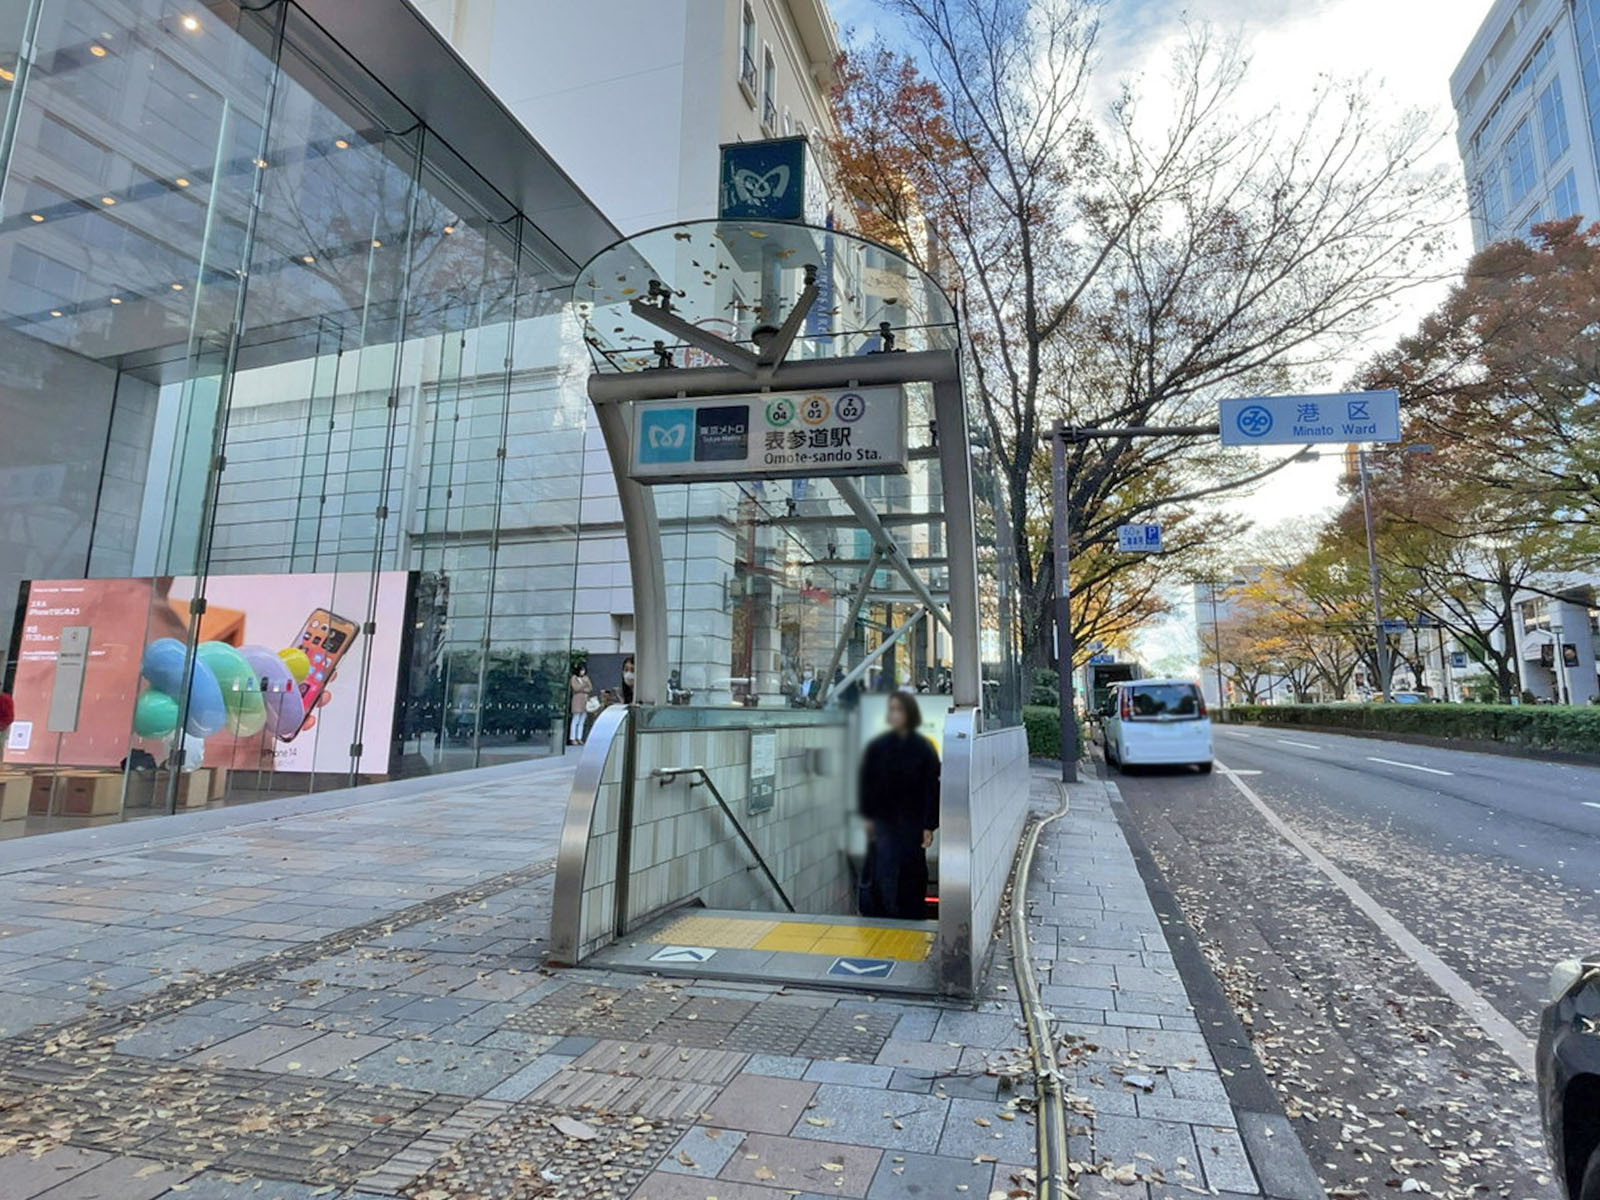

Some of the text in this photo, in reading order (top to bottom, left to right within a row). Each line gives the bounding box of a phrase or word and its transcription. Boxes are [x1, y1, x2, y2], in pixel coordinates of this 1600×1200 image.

[777, 402, 784, 411] C
[811, 400, 819, 408] G
[848, 398, 854, 406] Z
[773, 411, 787, 421] 04
[807, 409, 821, 419] 02
[843, 407, 857, 417] 02
[1292, 422, 1377, 437] Minato Ward
[765, 427, 851, 450] 表参道駅
[764, 448, 882, 464] Omote-sando Sta.
